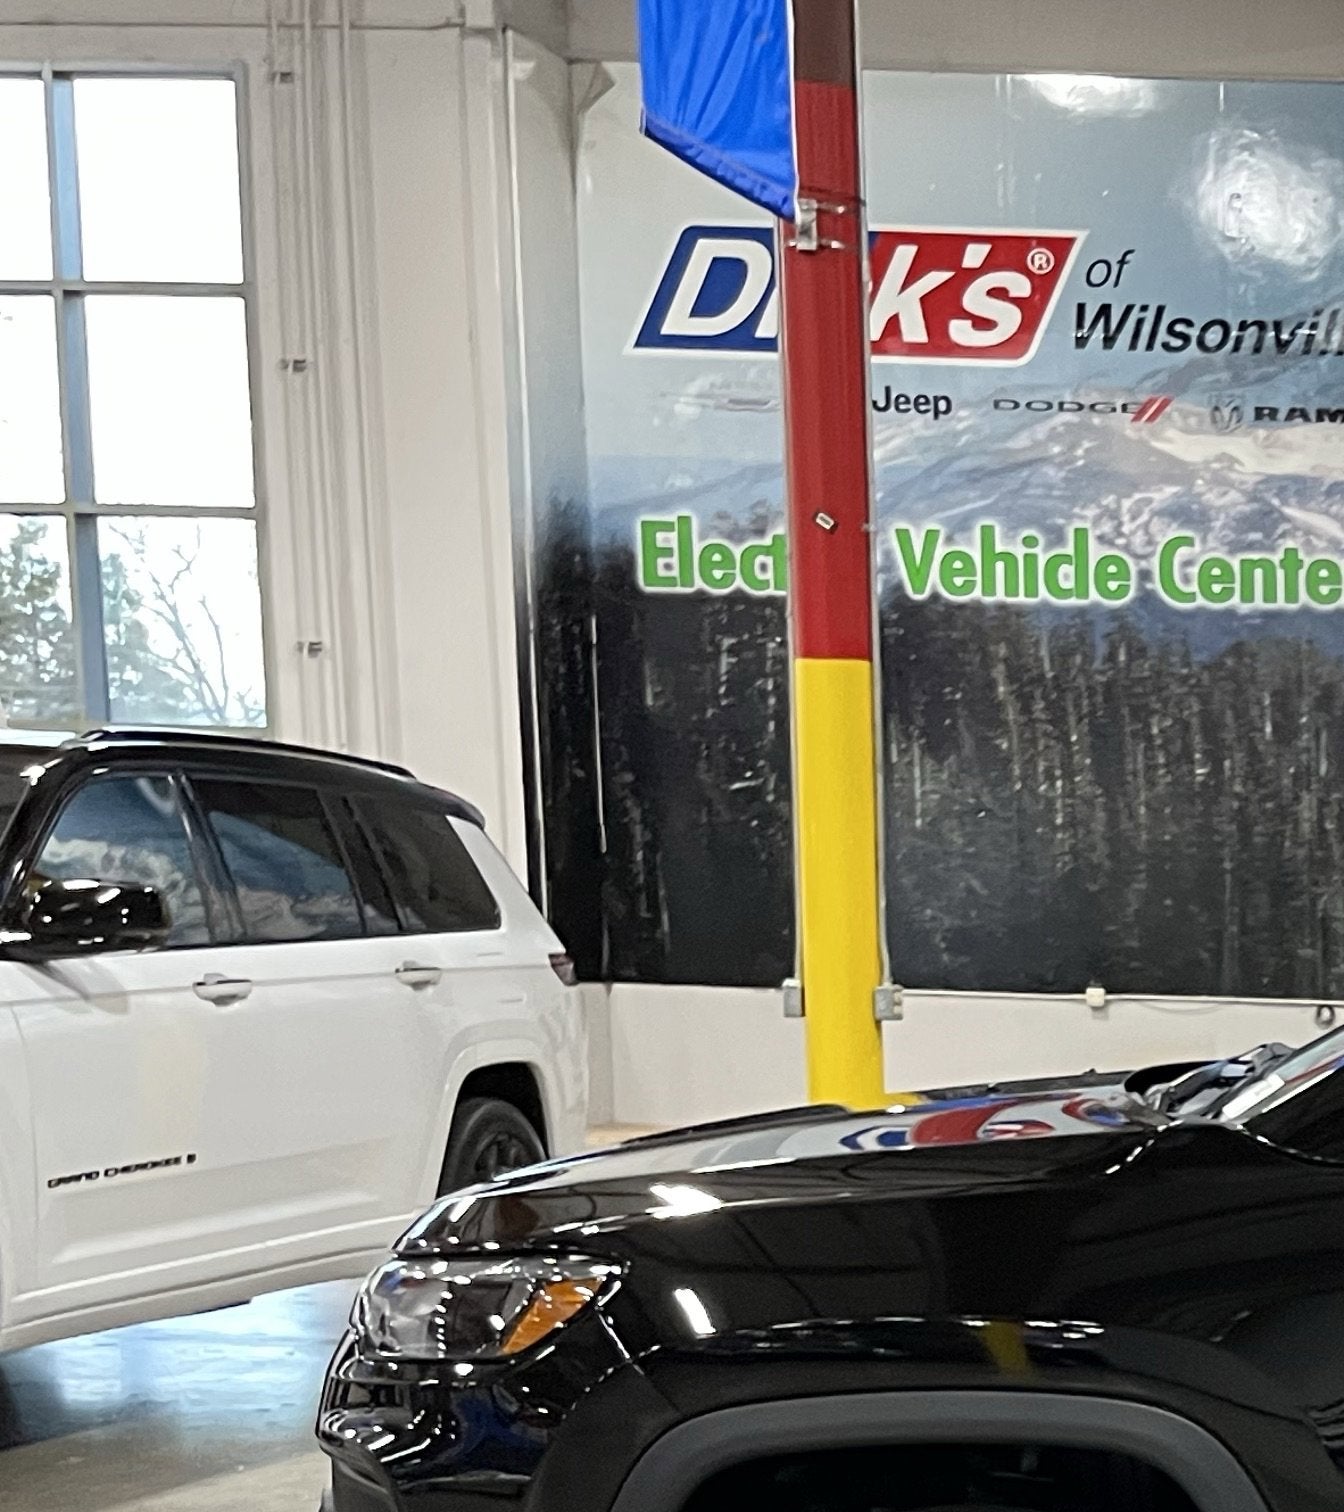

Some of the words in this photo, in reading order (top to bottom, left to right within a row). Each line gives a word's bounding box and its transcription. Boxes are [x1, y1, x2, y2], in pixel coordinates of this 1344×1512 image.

[1085, 249, 1136, 289] of
[660, 238, 1032, 347] Dk's
[871, 385, 953, 420] Jeep
[993, 398, 1142, 416] DODGE
[640, 515, 788, 592] Elect
[894, 524, 1132, 601] Vehicle
